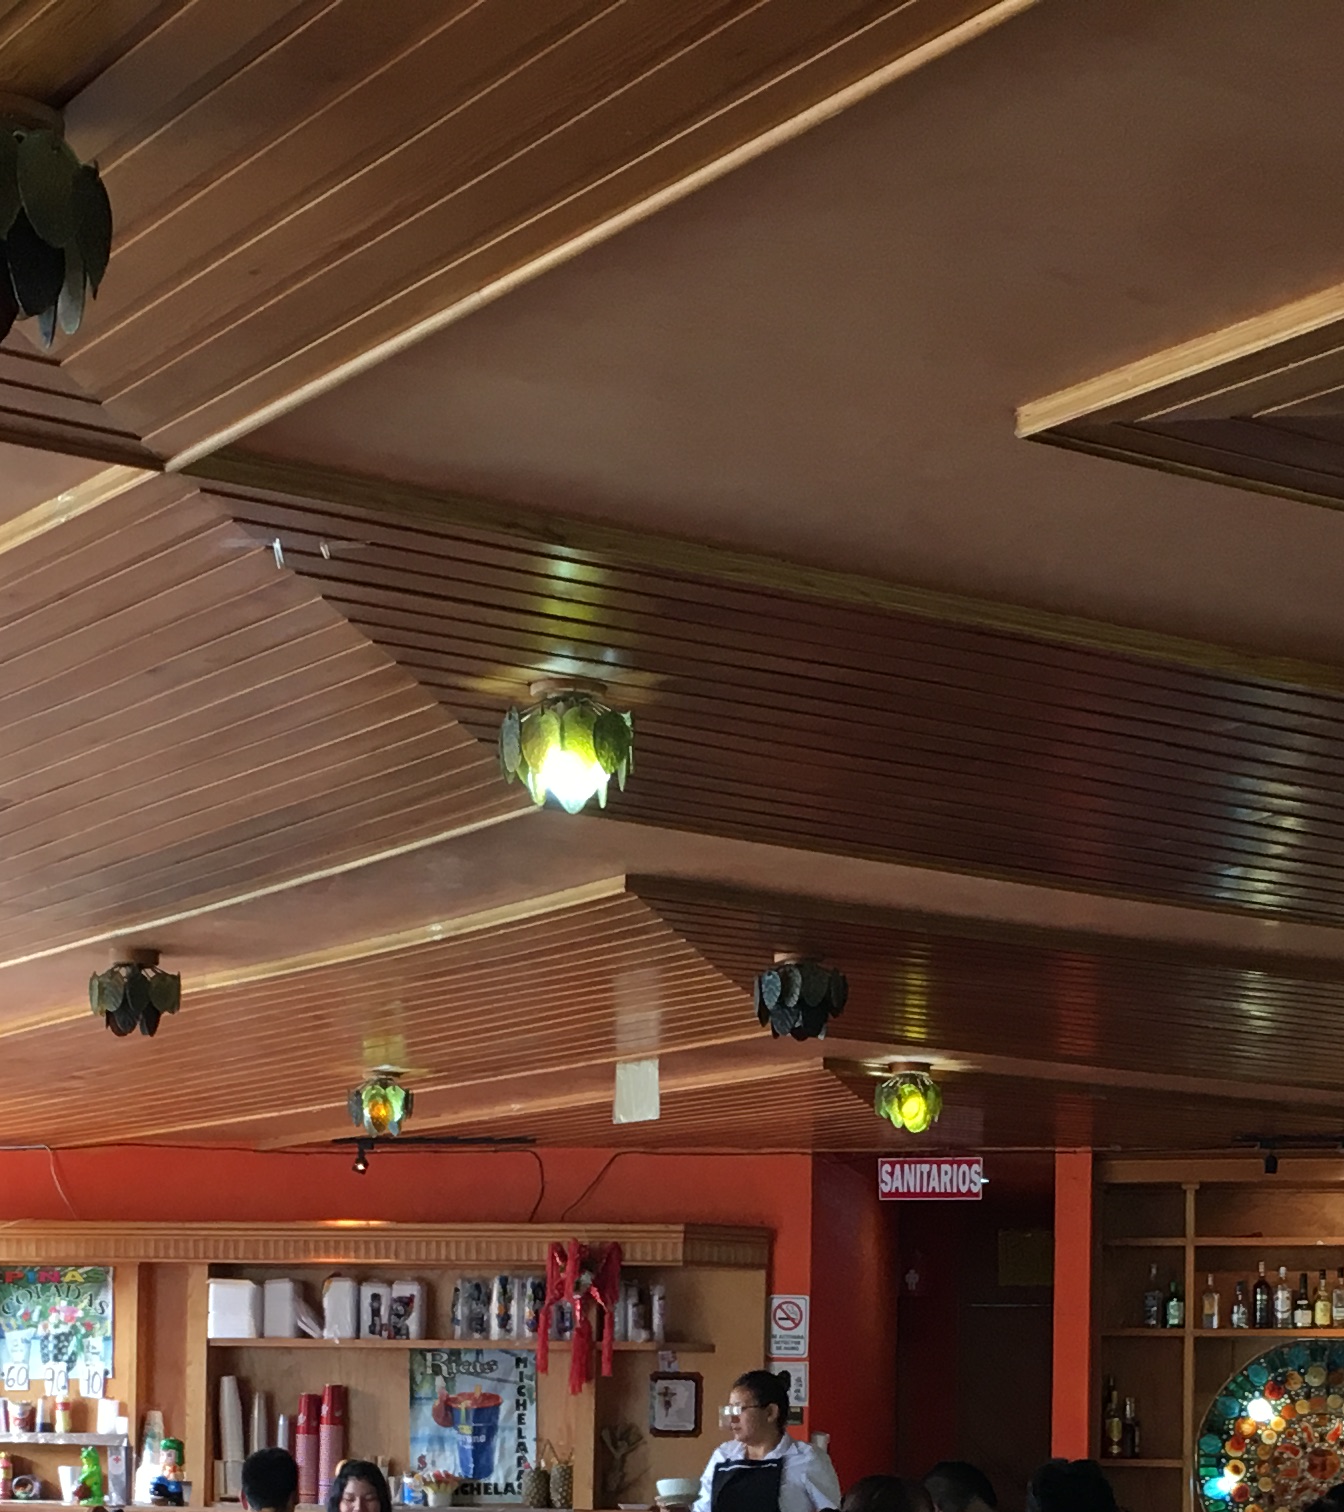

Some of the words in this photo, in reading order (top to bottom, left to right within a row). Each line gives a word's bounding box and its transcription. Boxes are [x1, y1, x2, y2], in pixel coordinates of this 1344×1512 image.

[880, 1163, 982, 1193] SANITARIOS
[1, 1284, 109, 1316] COLADAS
[6, 1366, 28, 1388] 60
[424, 1351, 499, 1377] Ricas
